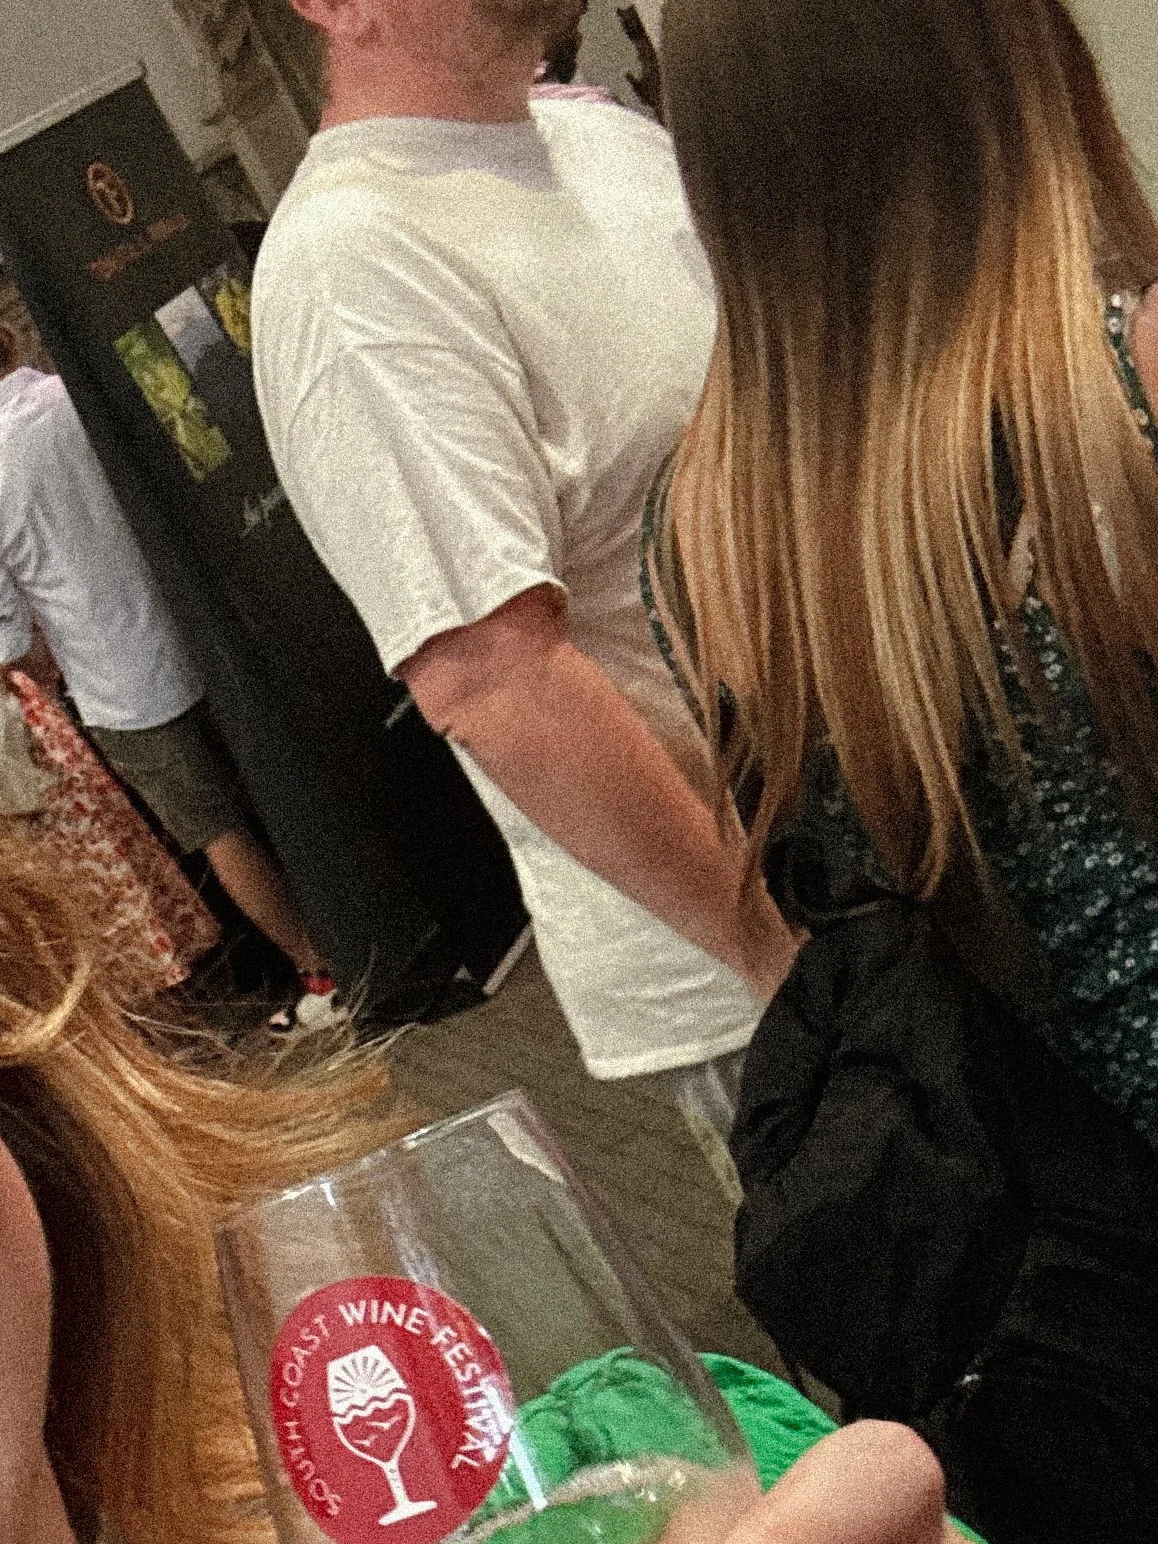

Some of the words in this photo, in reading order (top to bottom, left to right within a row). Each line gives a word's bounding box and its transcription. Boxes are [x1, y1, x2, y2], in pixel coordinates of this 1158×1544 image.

[279, 1314, 331, 1408] COAST
[337, 1299, 430, 1335] WINE
[430, 1325, 497, 1470] FESTIVAL
[282, 1420, 343, 1516] SOUTH
